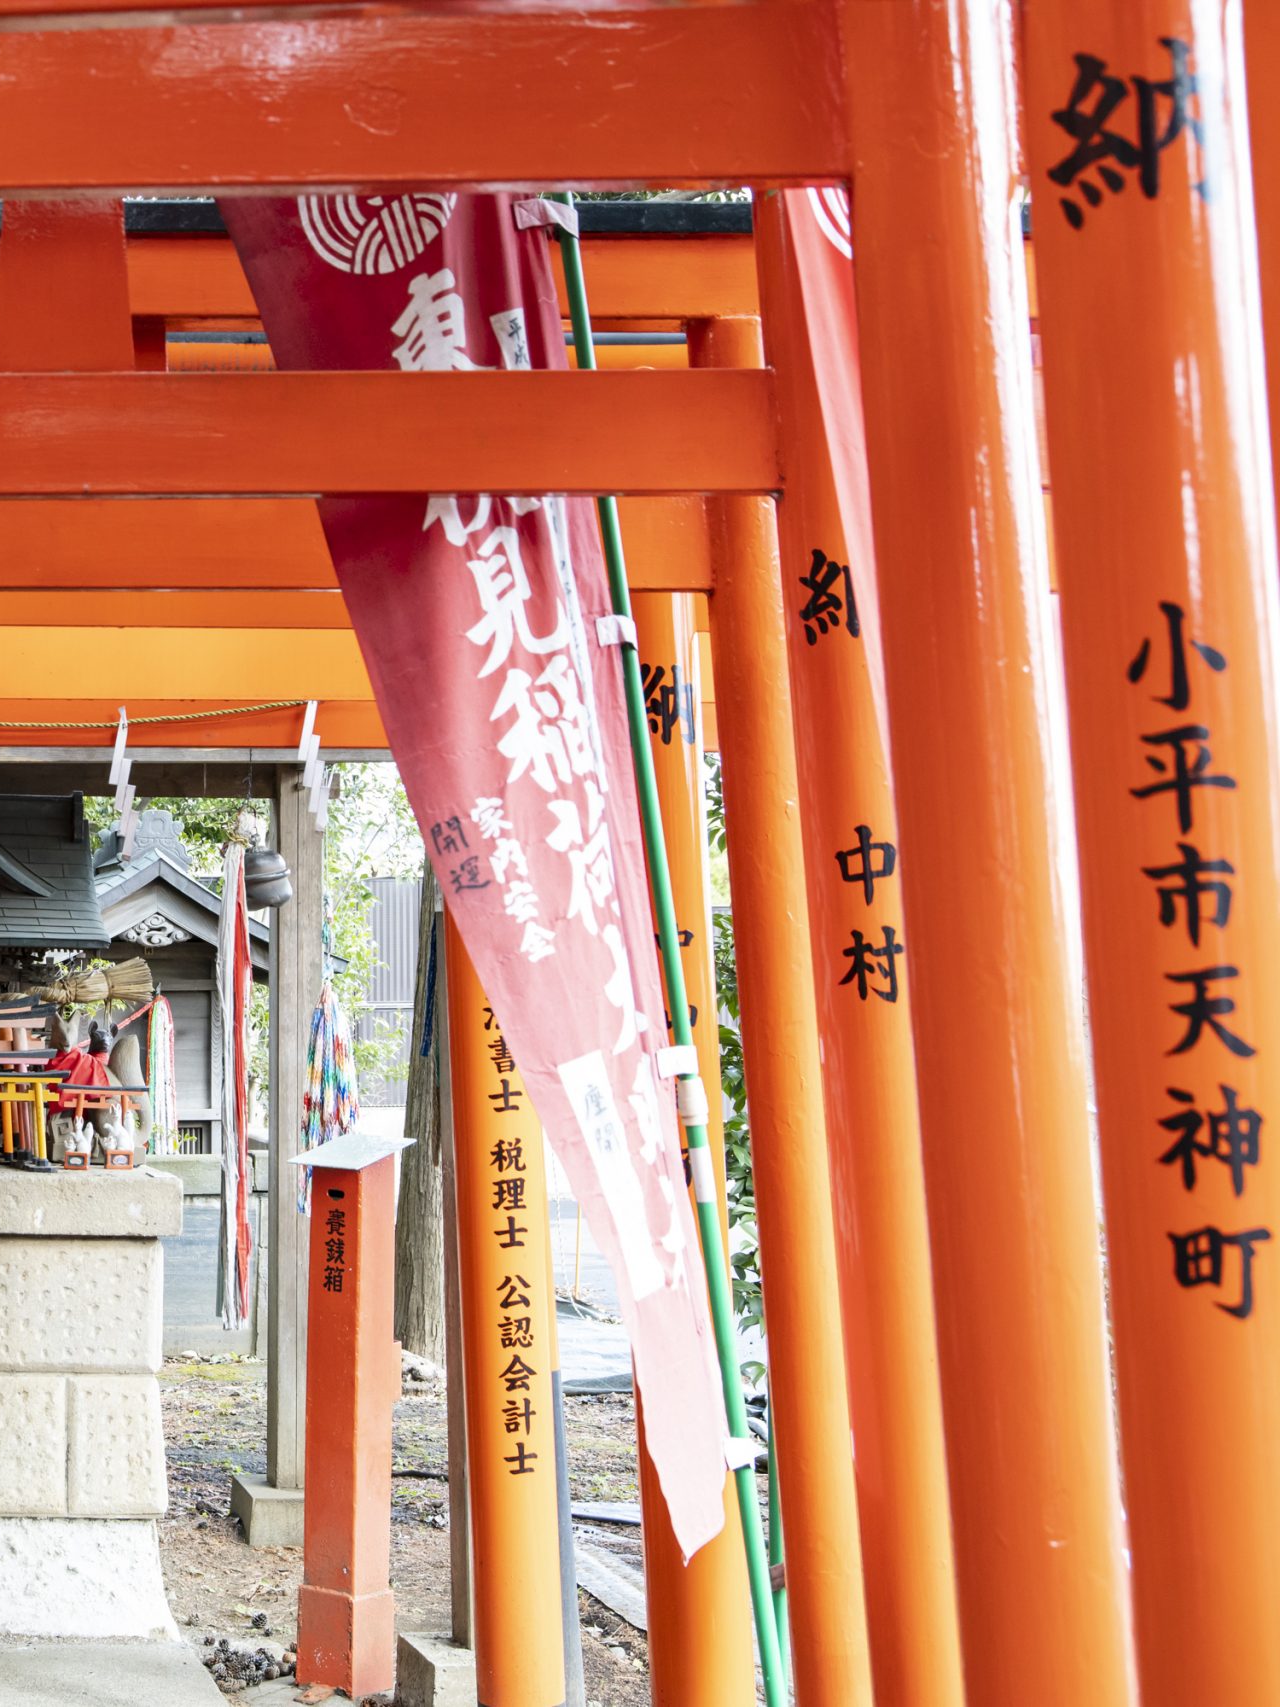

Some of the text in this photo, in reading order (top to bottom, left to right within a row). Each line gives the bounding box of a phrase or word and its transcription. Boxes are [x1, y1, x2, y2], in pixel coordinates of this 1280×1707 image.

[430, 815, 492, 894] 開運
[834, 824, 904, 1003] 中村
[1126, 601, 1272, 1320] 小平市天神町
[323, 1208, 346, 1293] 賽銭箱
[489, 1137, 529, 1249] 税理士
[495, 1273, 538, 1475] 公認会計士
